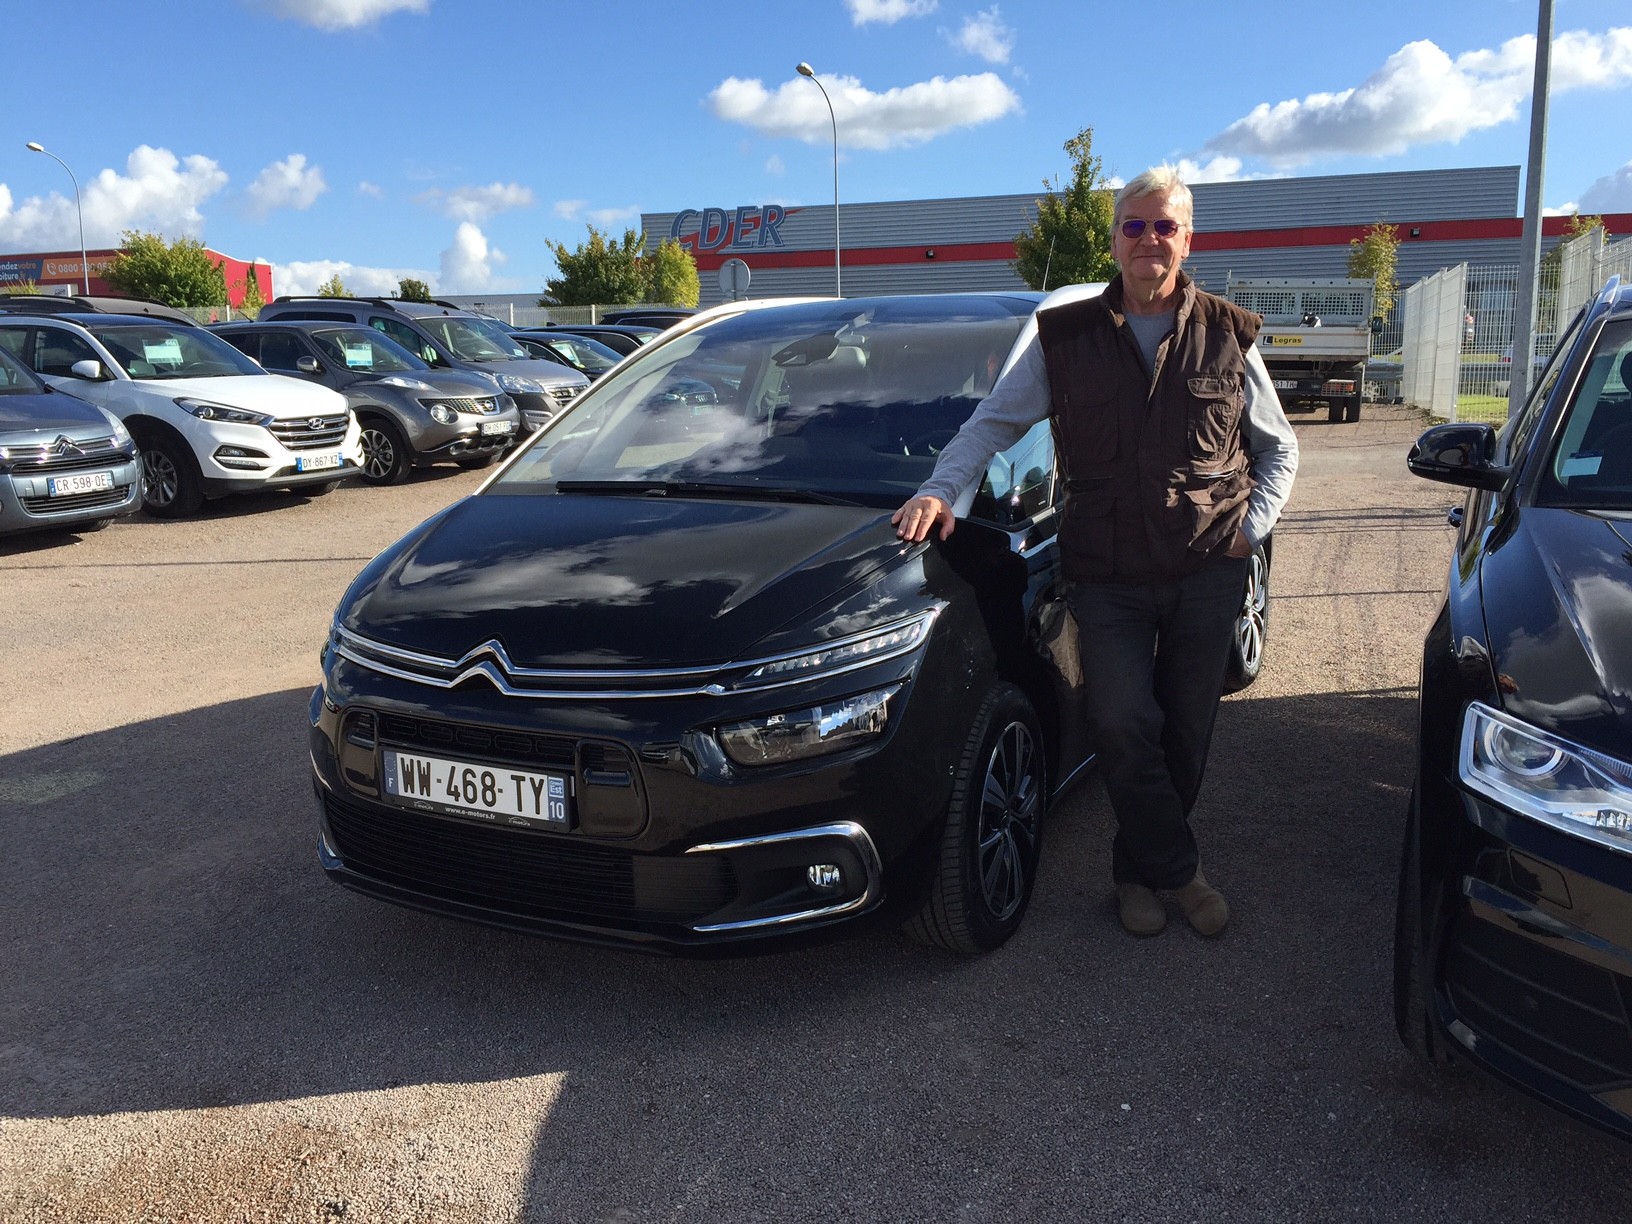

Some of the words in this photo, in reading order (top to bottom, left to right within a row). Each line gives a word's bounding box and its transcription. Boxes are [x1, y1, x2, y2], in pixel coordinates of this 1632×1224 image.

[669, 204, 786, 249] CDER
[58, 263, 79, 273] 0800
[388, 777, 394, 788] F
[400, 757, 545, 815] WW-468-TY
[550, 785, 562, 794] Est
[445, 806, 496, 820] www.e-motors.fr
[549, 800, 565, 819] 10
